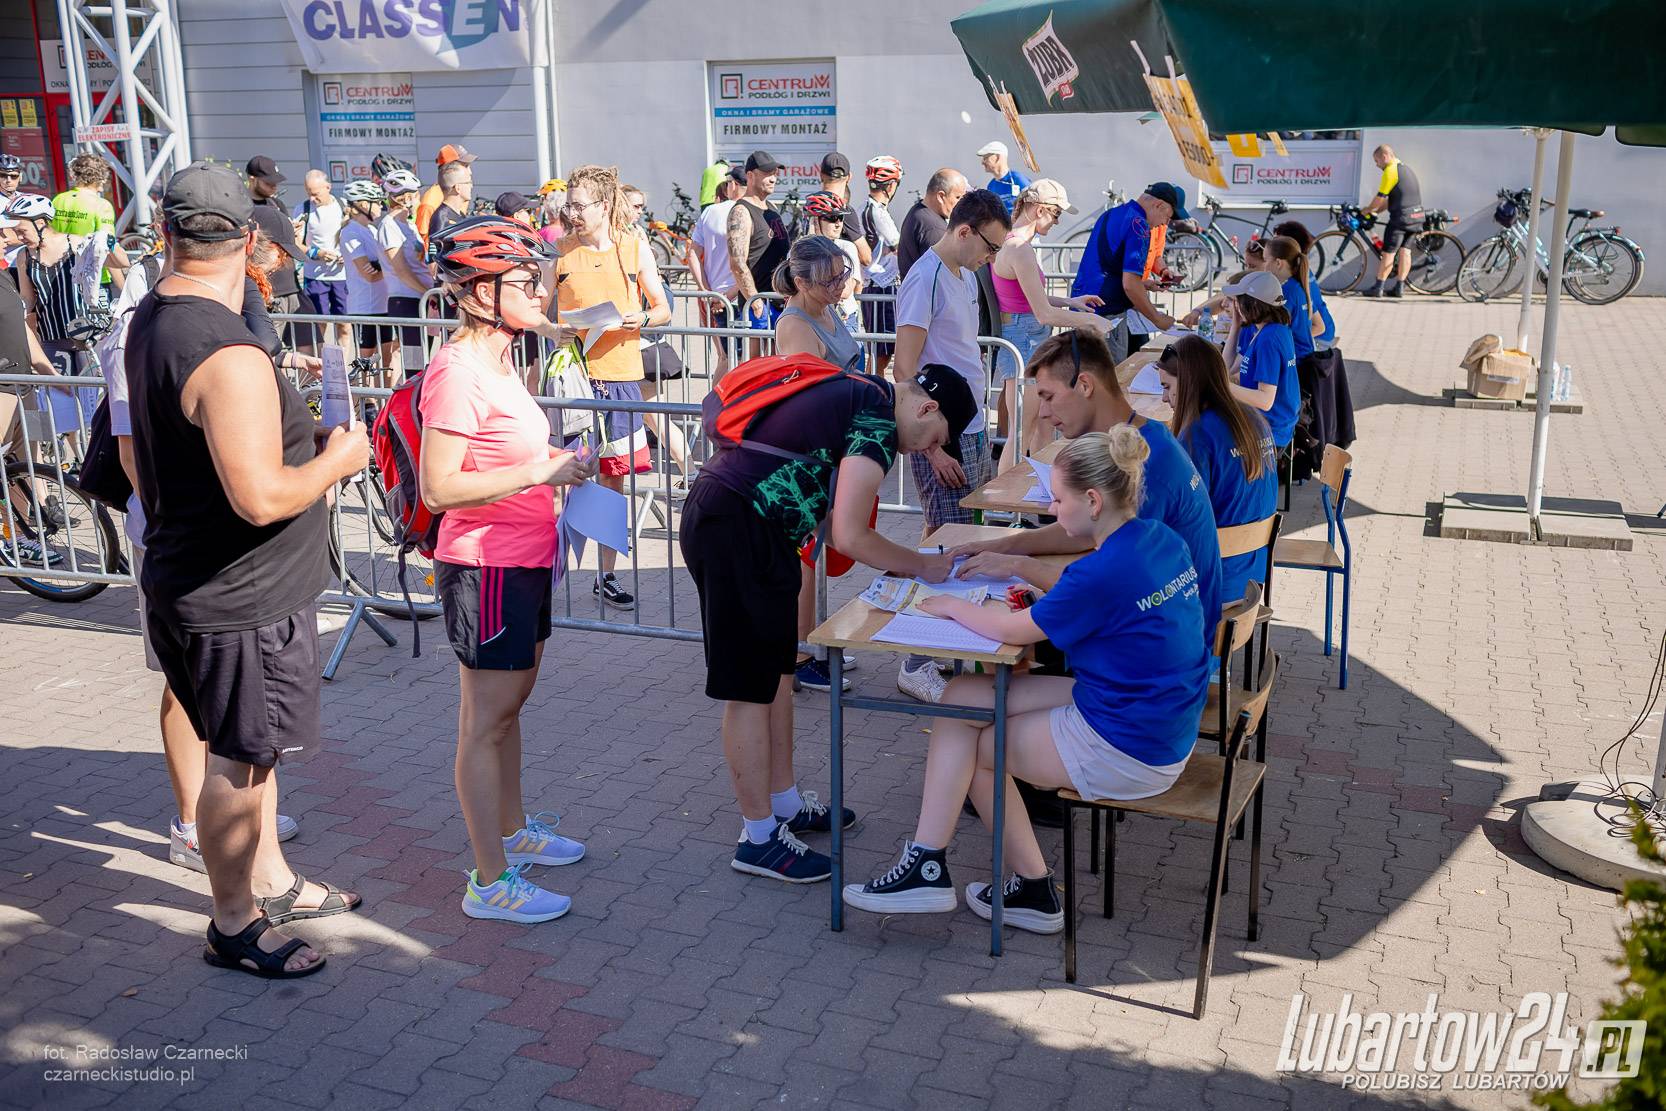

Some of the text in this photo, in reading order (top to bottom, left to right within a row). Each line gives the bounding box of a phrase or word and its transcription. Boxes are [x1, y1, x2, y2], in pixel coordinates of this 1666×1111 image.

[303, 0, 520, 41] CLASSEN
[748, 74, 830, 91] CENTRUM
[346, 84, 414, 97] CENTRUM
[748, 91, 789, 99] PODŁÓG
[782, 106, 829, 115] GARAŻOWE
[329, 126, 415, 138] FIRMOWY MONTAŻ
[723, 121, 828, 135] FIRMOWY MONTAŻ
[1257, 166, 1332, 178] CENTRUM
[1136, 566, 1198, 612] WOLONTARIUS
